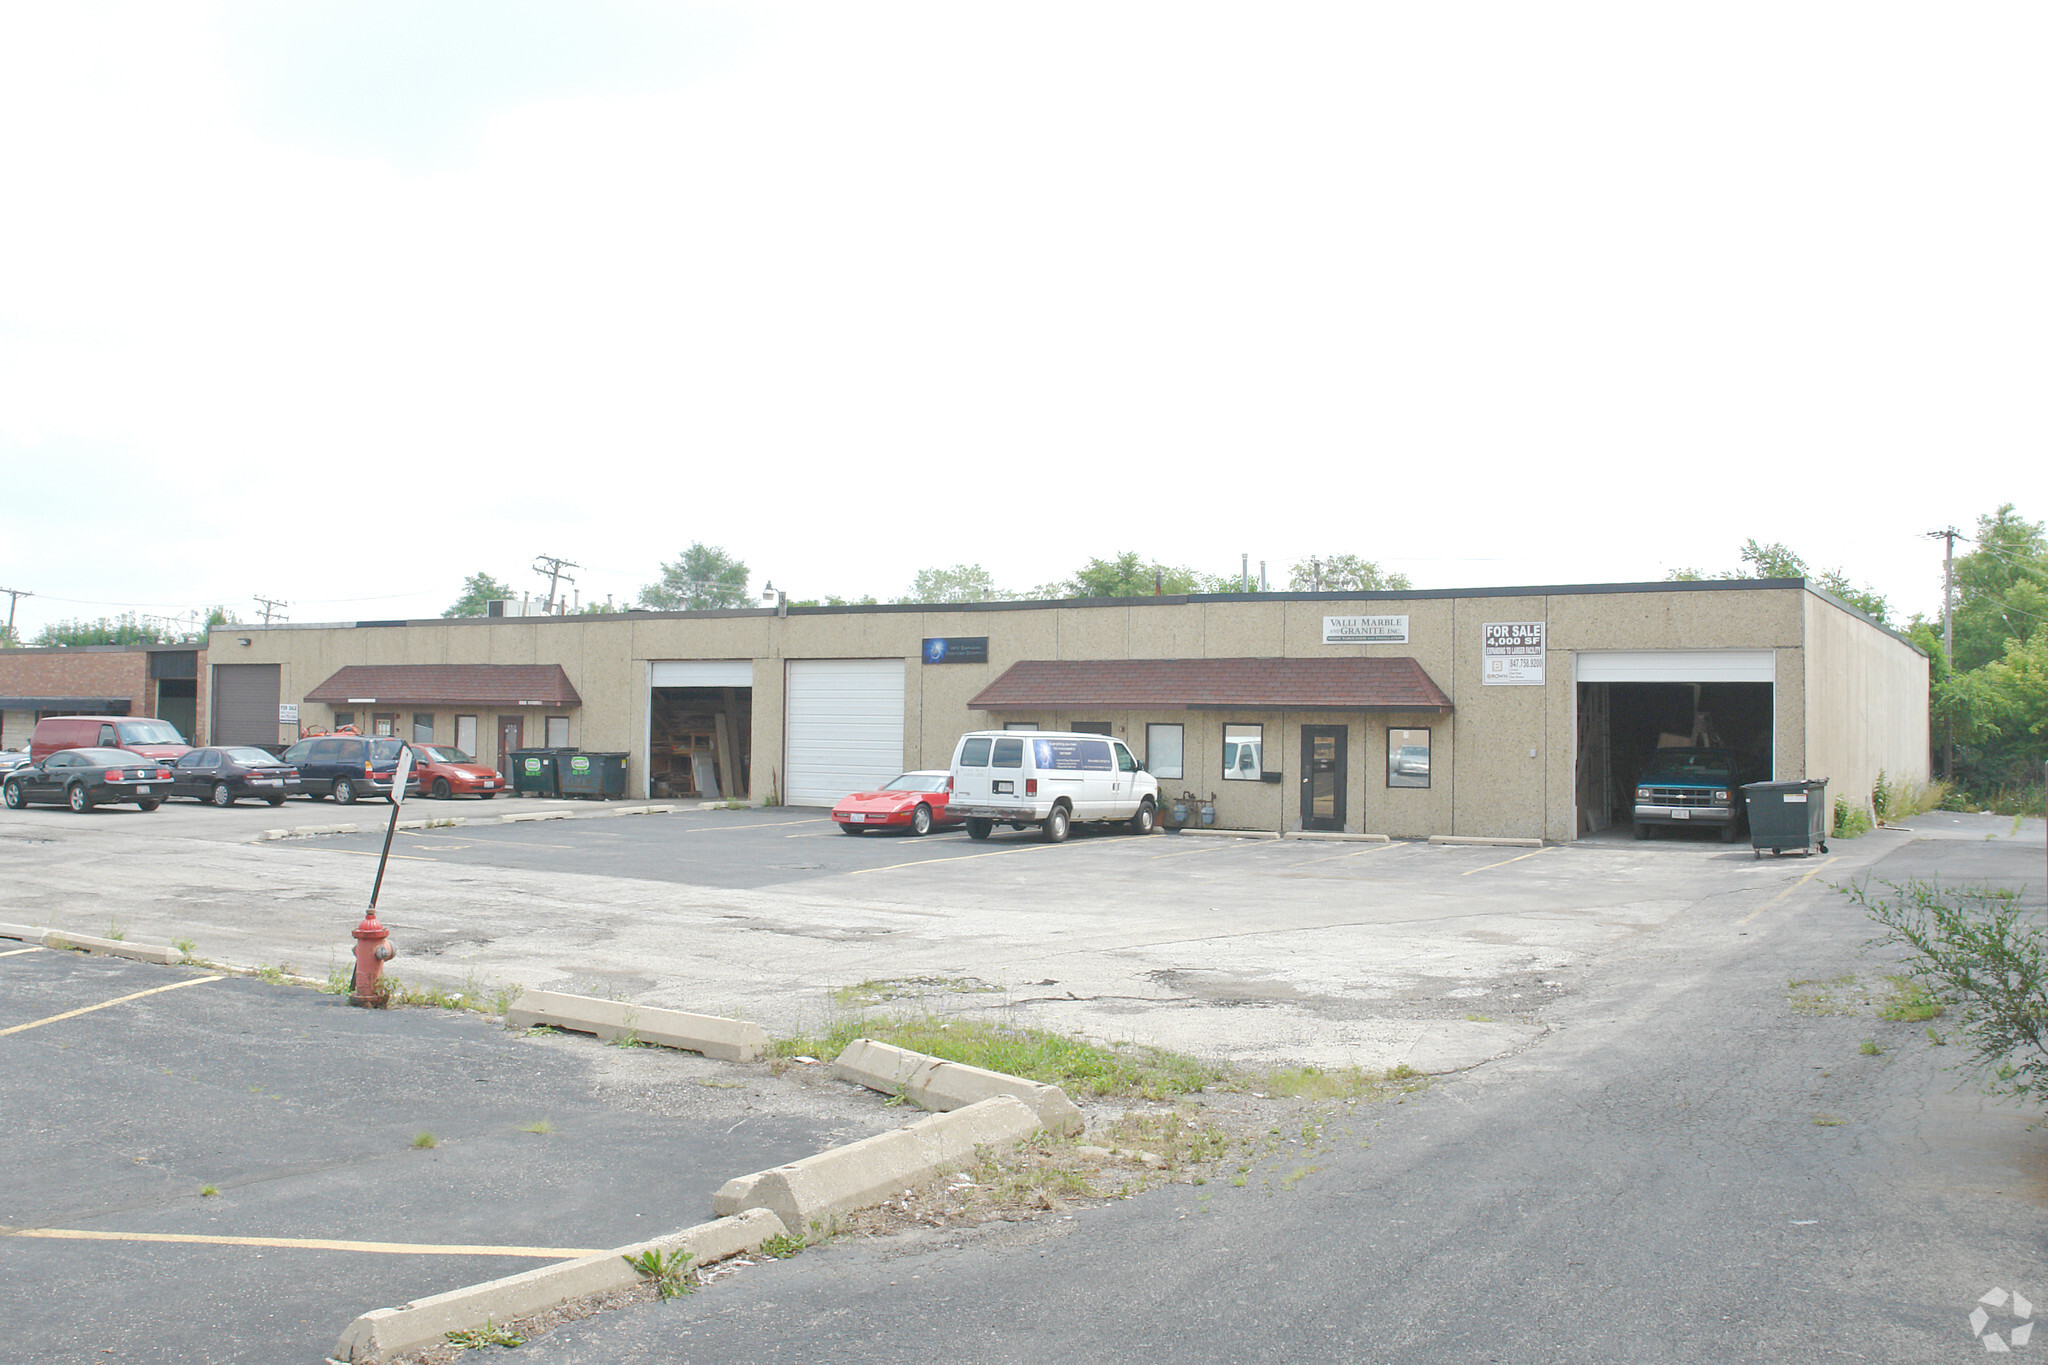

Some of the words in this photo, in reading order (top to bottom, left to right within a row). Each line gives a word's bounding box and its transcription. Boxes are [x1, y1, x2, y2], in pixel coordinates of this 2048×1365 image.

[1361, 618, 1402, 626] MARBLE
[1340, 627, 1384, 635] GRANITE
[1487, 626, 1509, 637] FOR
[1512, 625, 1540, 637] SALE
[1487, 637, 1521, 646] 4,000
[1524, 637, 1540, 645] SF
